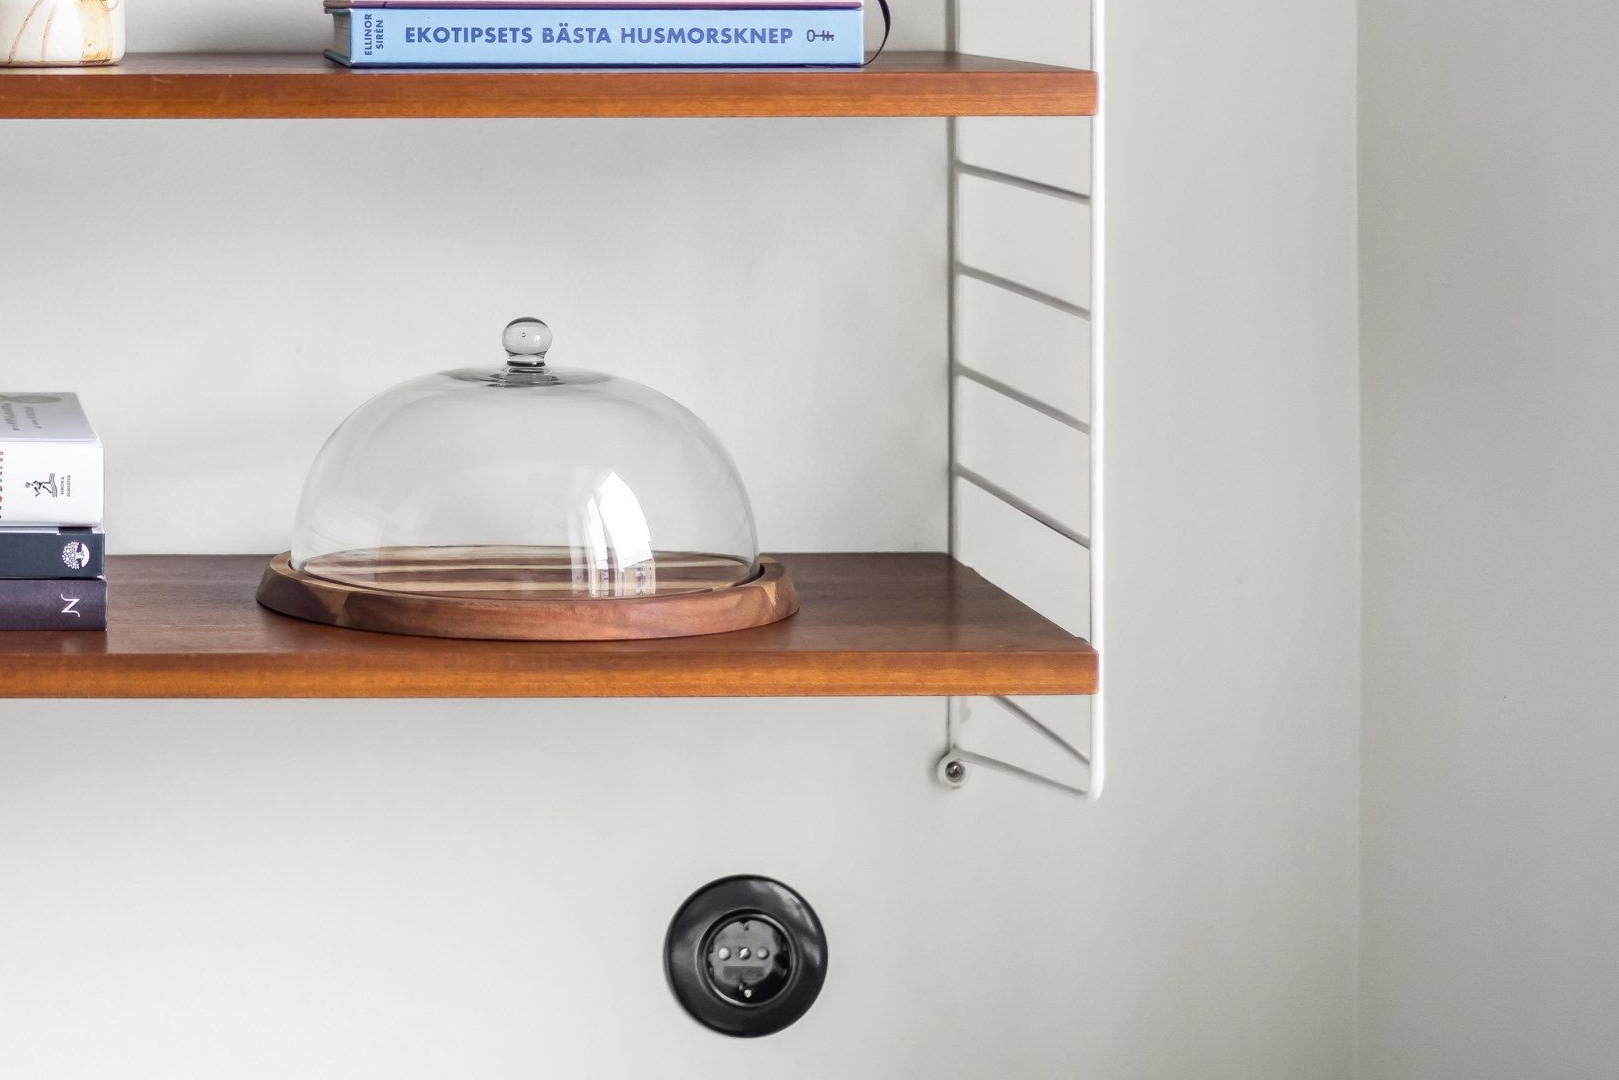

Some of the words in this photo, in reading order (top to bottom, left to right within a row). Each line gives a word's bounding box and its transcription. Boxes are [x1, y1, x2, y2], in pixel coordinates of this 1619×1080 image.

[364, 13, 373, 56] ELLINOR
[374, 19, 384, 50] SIRÉN
[405, 26, 533, 44] EKOTIPSETS
[542, 22, 612, 44] BÄSTA
[620, 27, 793, 45] HUSMORSKNEP
